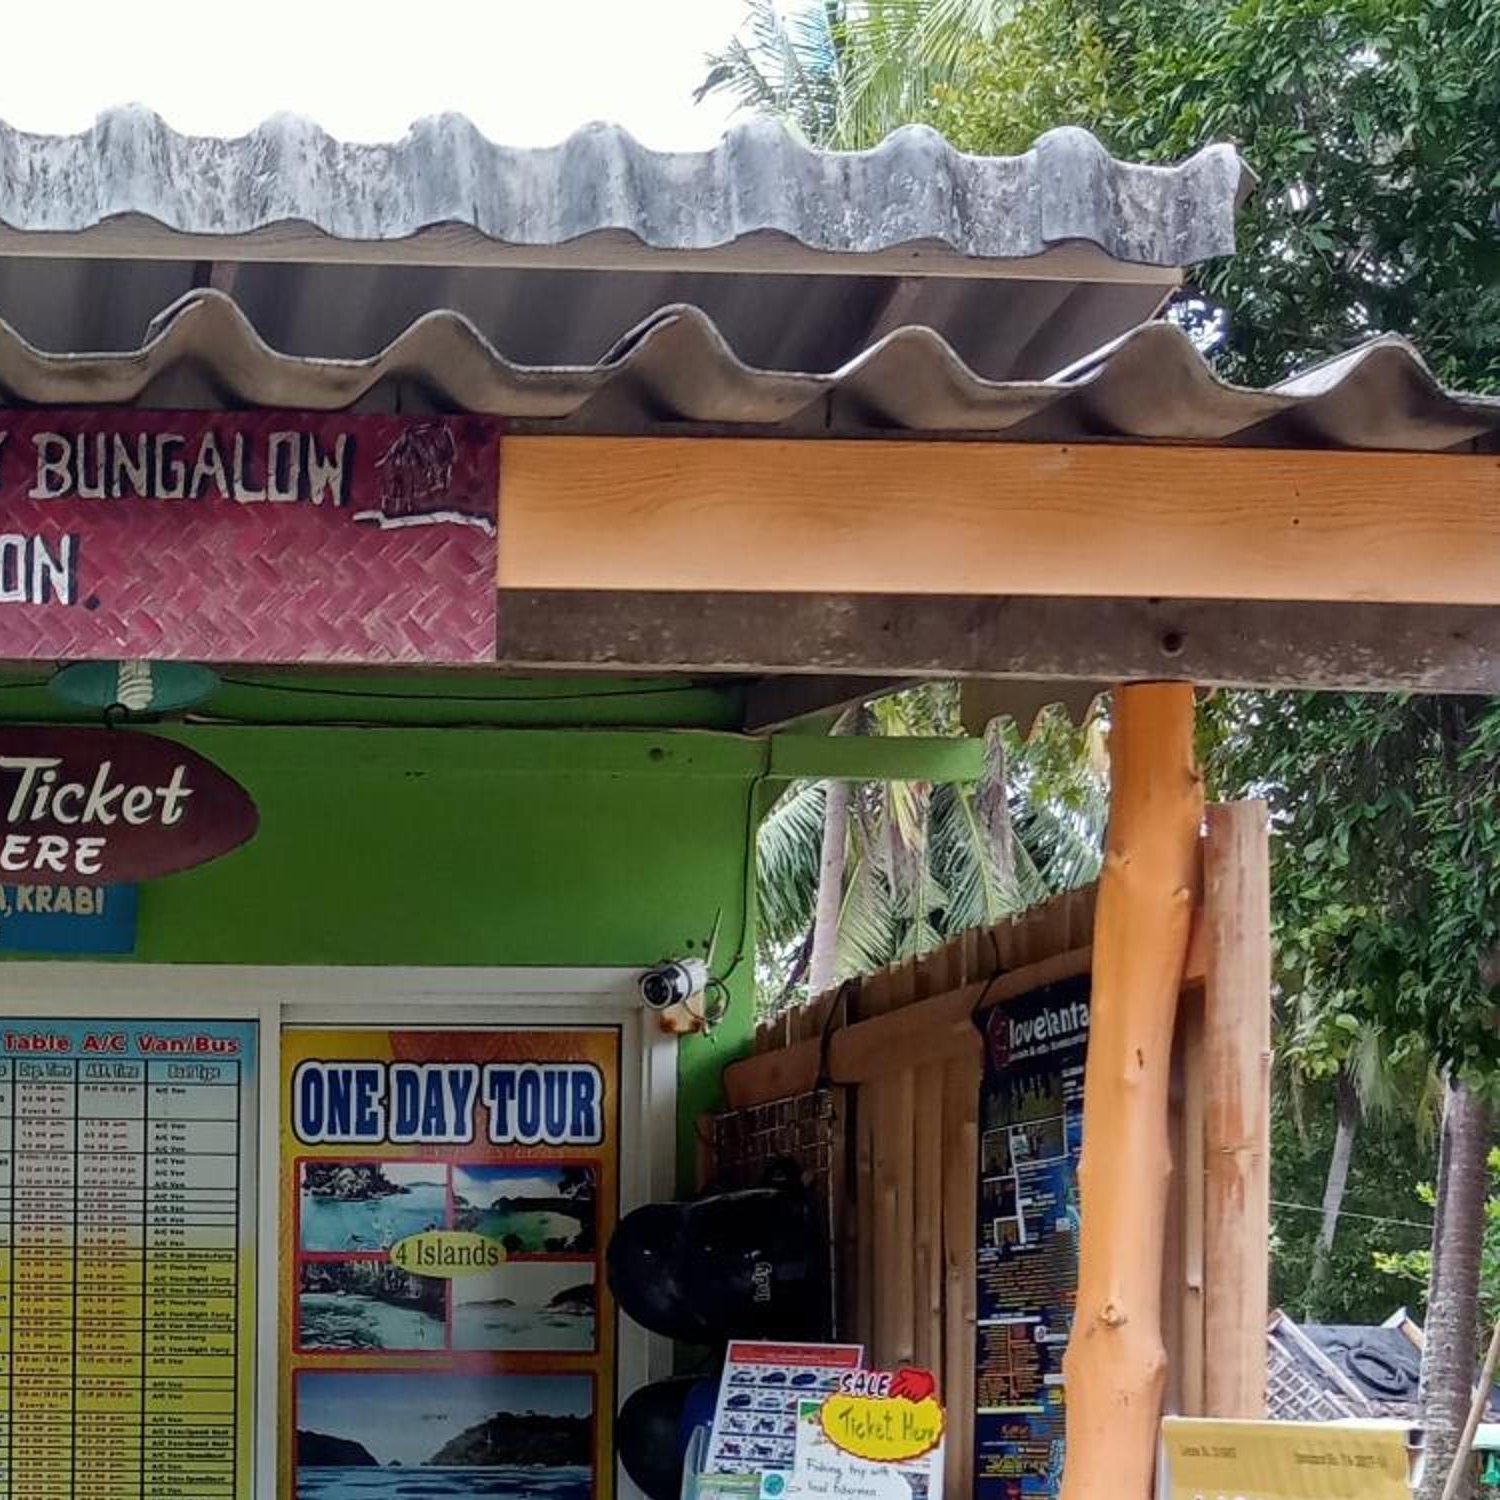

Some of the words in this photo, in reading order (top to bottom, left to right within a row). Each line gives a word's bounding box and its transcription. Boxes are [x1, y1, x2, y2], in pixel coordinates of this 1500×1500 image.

[29, 430, 354, 508] BUNGALOW
[4, 1033, 70, 1053] Table
[84, 1034, 126, 1053] A/C
[139, 1035, 241, 1056] Van/Bus
[298, 1065, 382, 1138] ONE
[393, 1067, 475, 1138] DAY
[488, 1067, 597, 1138] TOUR
[395, 1243, 408, 1266] 4
[416, 1240, 499, 1267] Islands
[840, 1372, 891, 1396] SALE
[838, 1406, 895, 1443] Ticket
